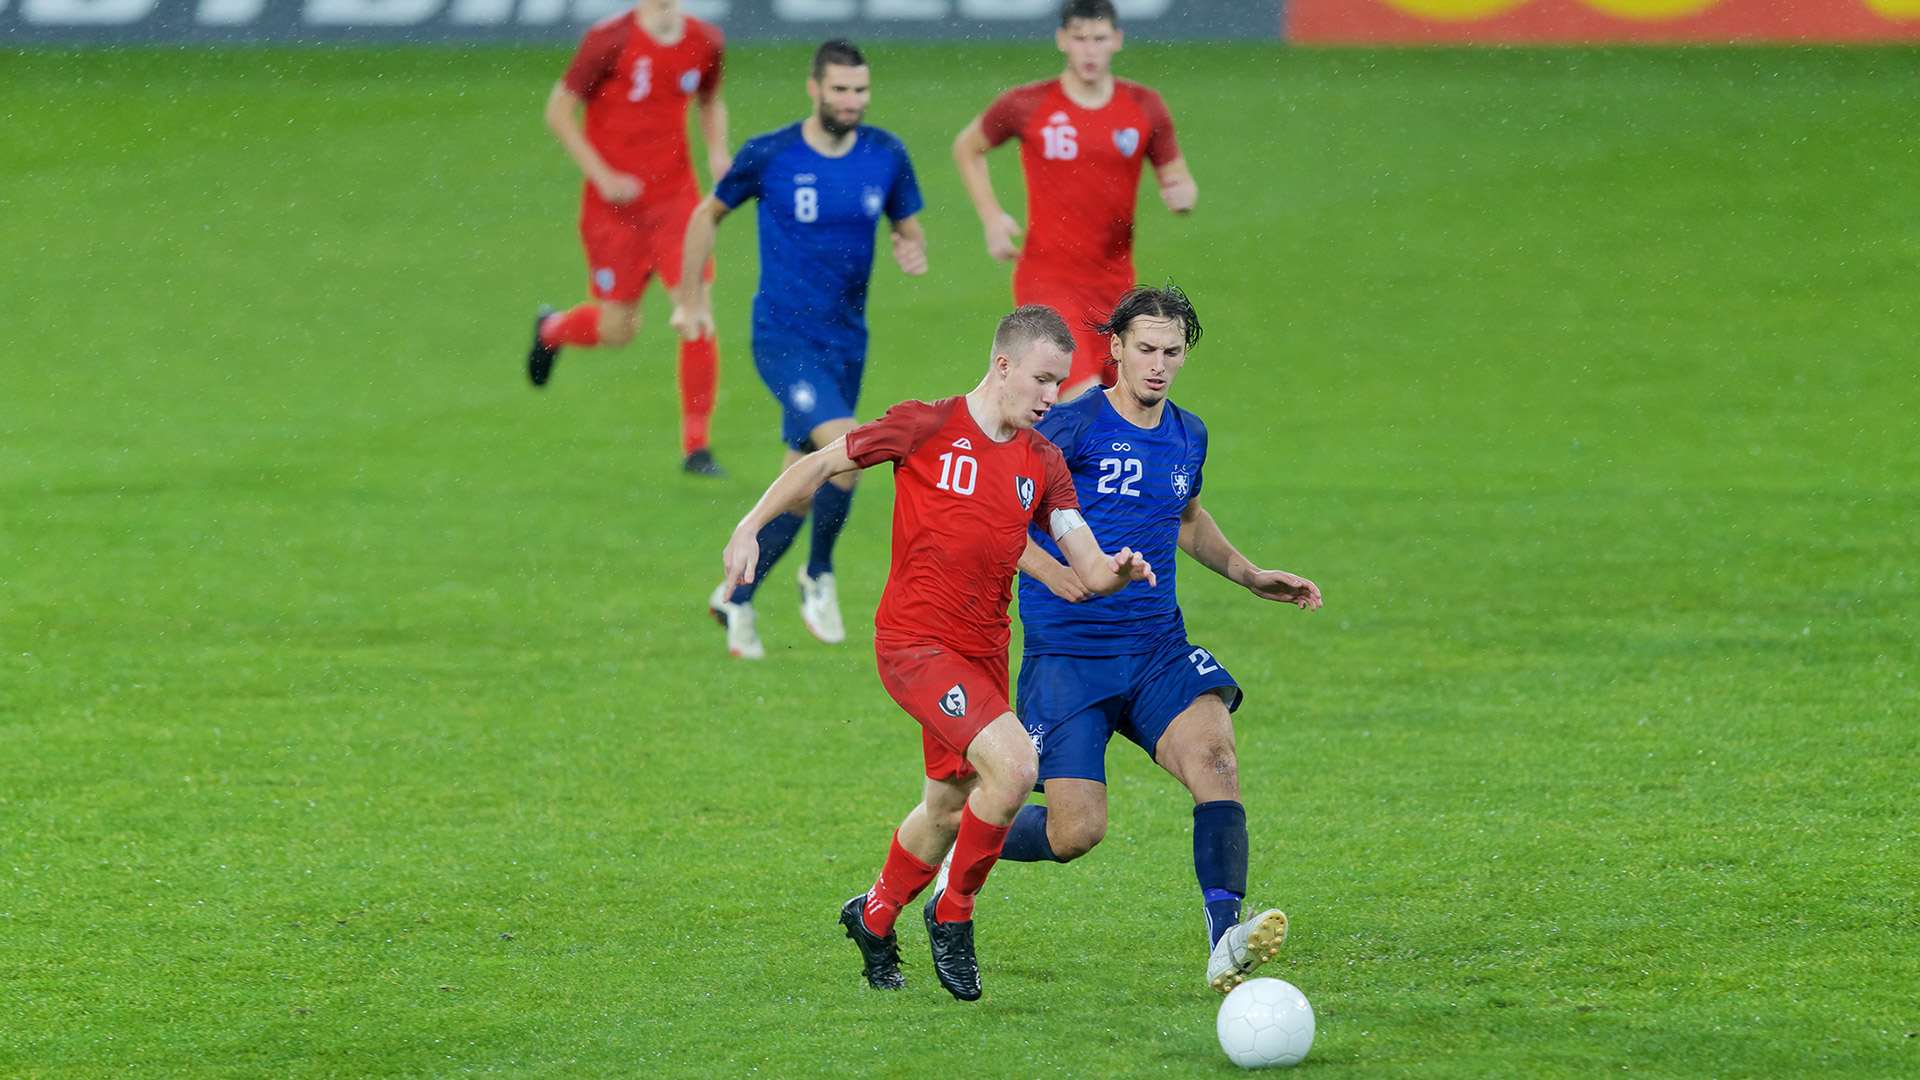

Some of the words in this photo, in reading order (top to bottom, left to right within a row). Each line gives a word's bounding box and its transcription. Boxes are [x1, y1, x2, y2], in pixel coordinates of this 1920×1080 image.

[1041, 125, 1078, 160] 16
[794, 187, 818, 223] 8
[936, 452, 977, 495] 10
[1097, 458, 1142, 497] 22
[1188, 648, 1224, 675] 2
